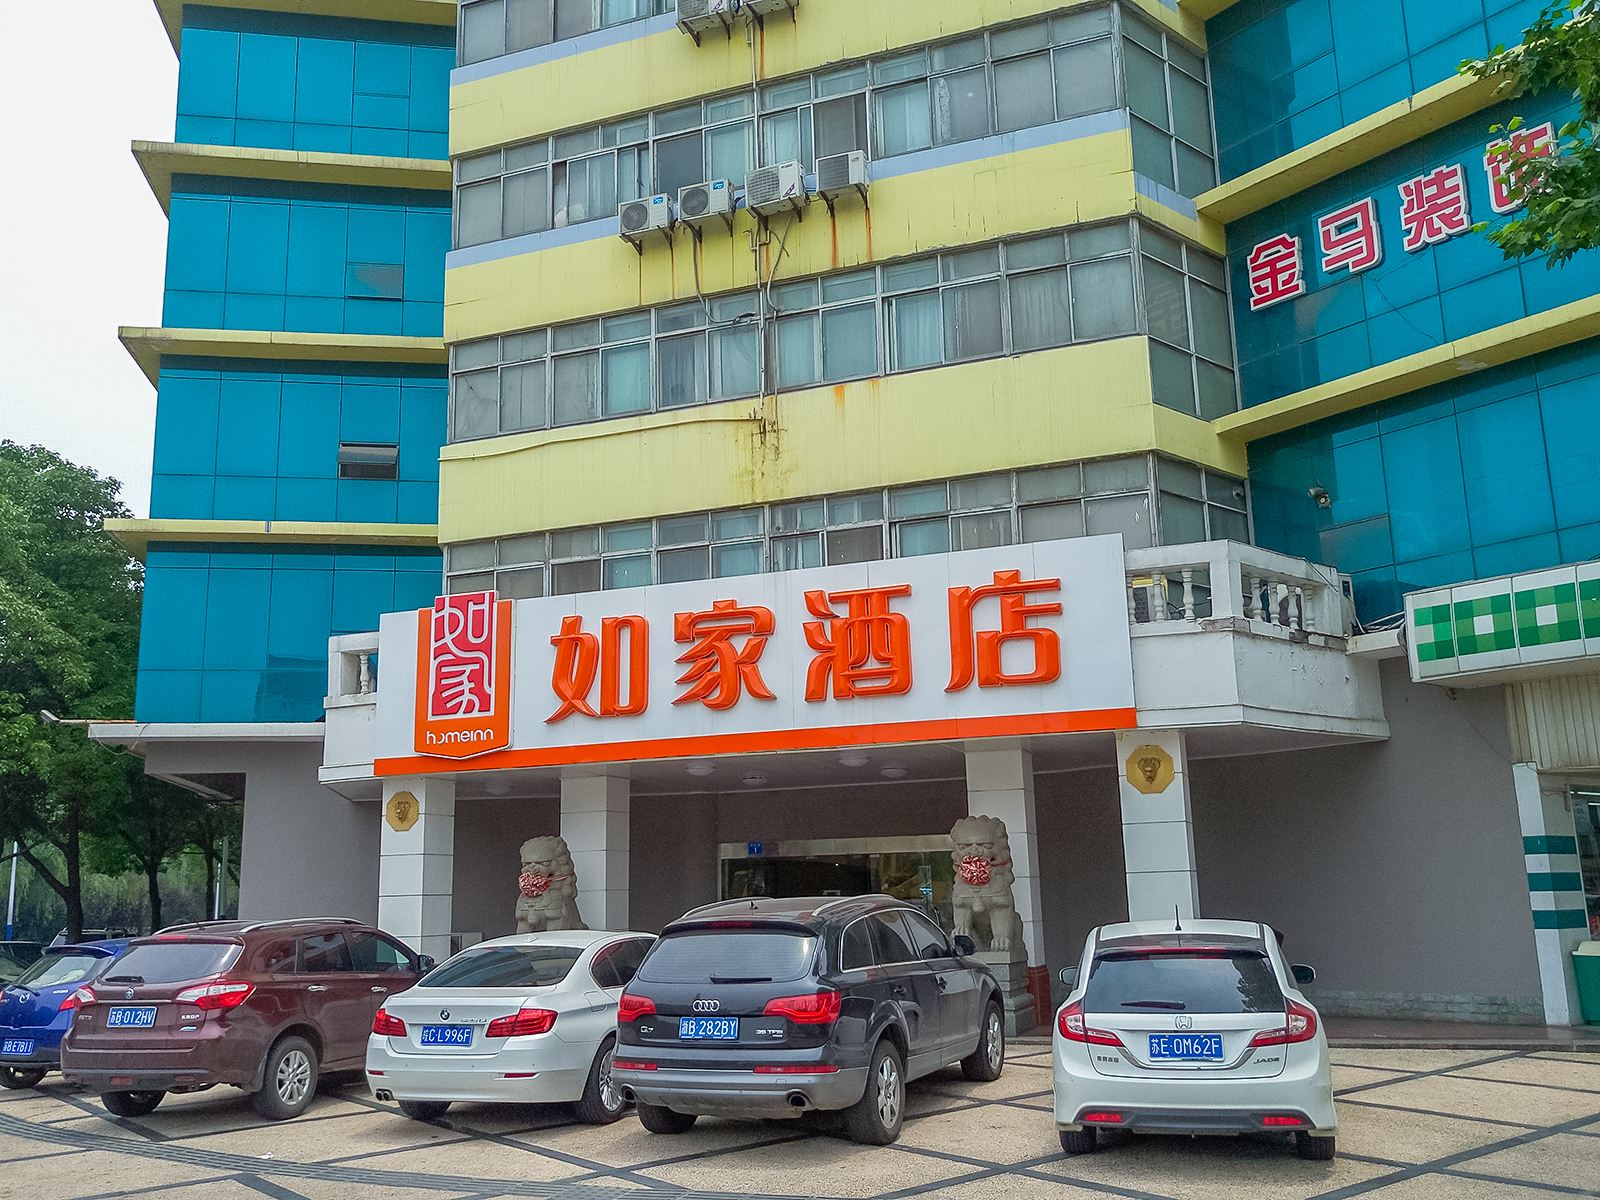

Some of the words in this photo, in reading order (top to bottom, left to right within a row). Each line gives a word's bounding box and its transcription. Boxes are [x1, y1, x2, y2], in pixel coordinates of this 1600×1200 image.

[433, 592, 498, 718] 如家
[542, 569, 1063, 724] 如家酒店
